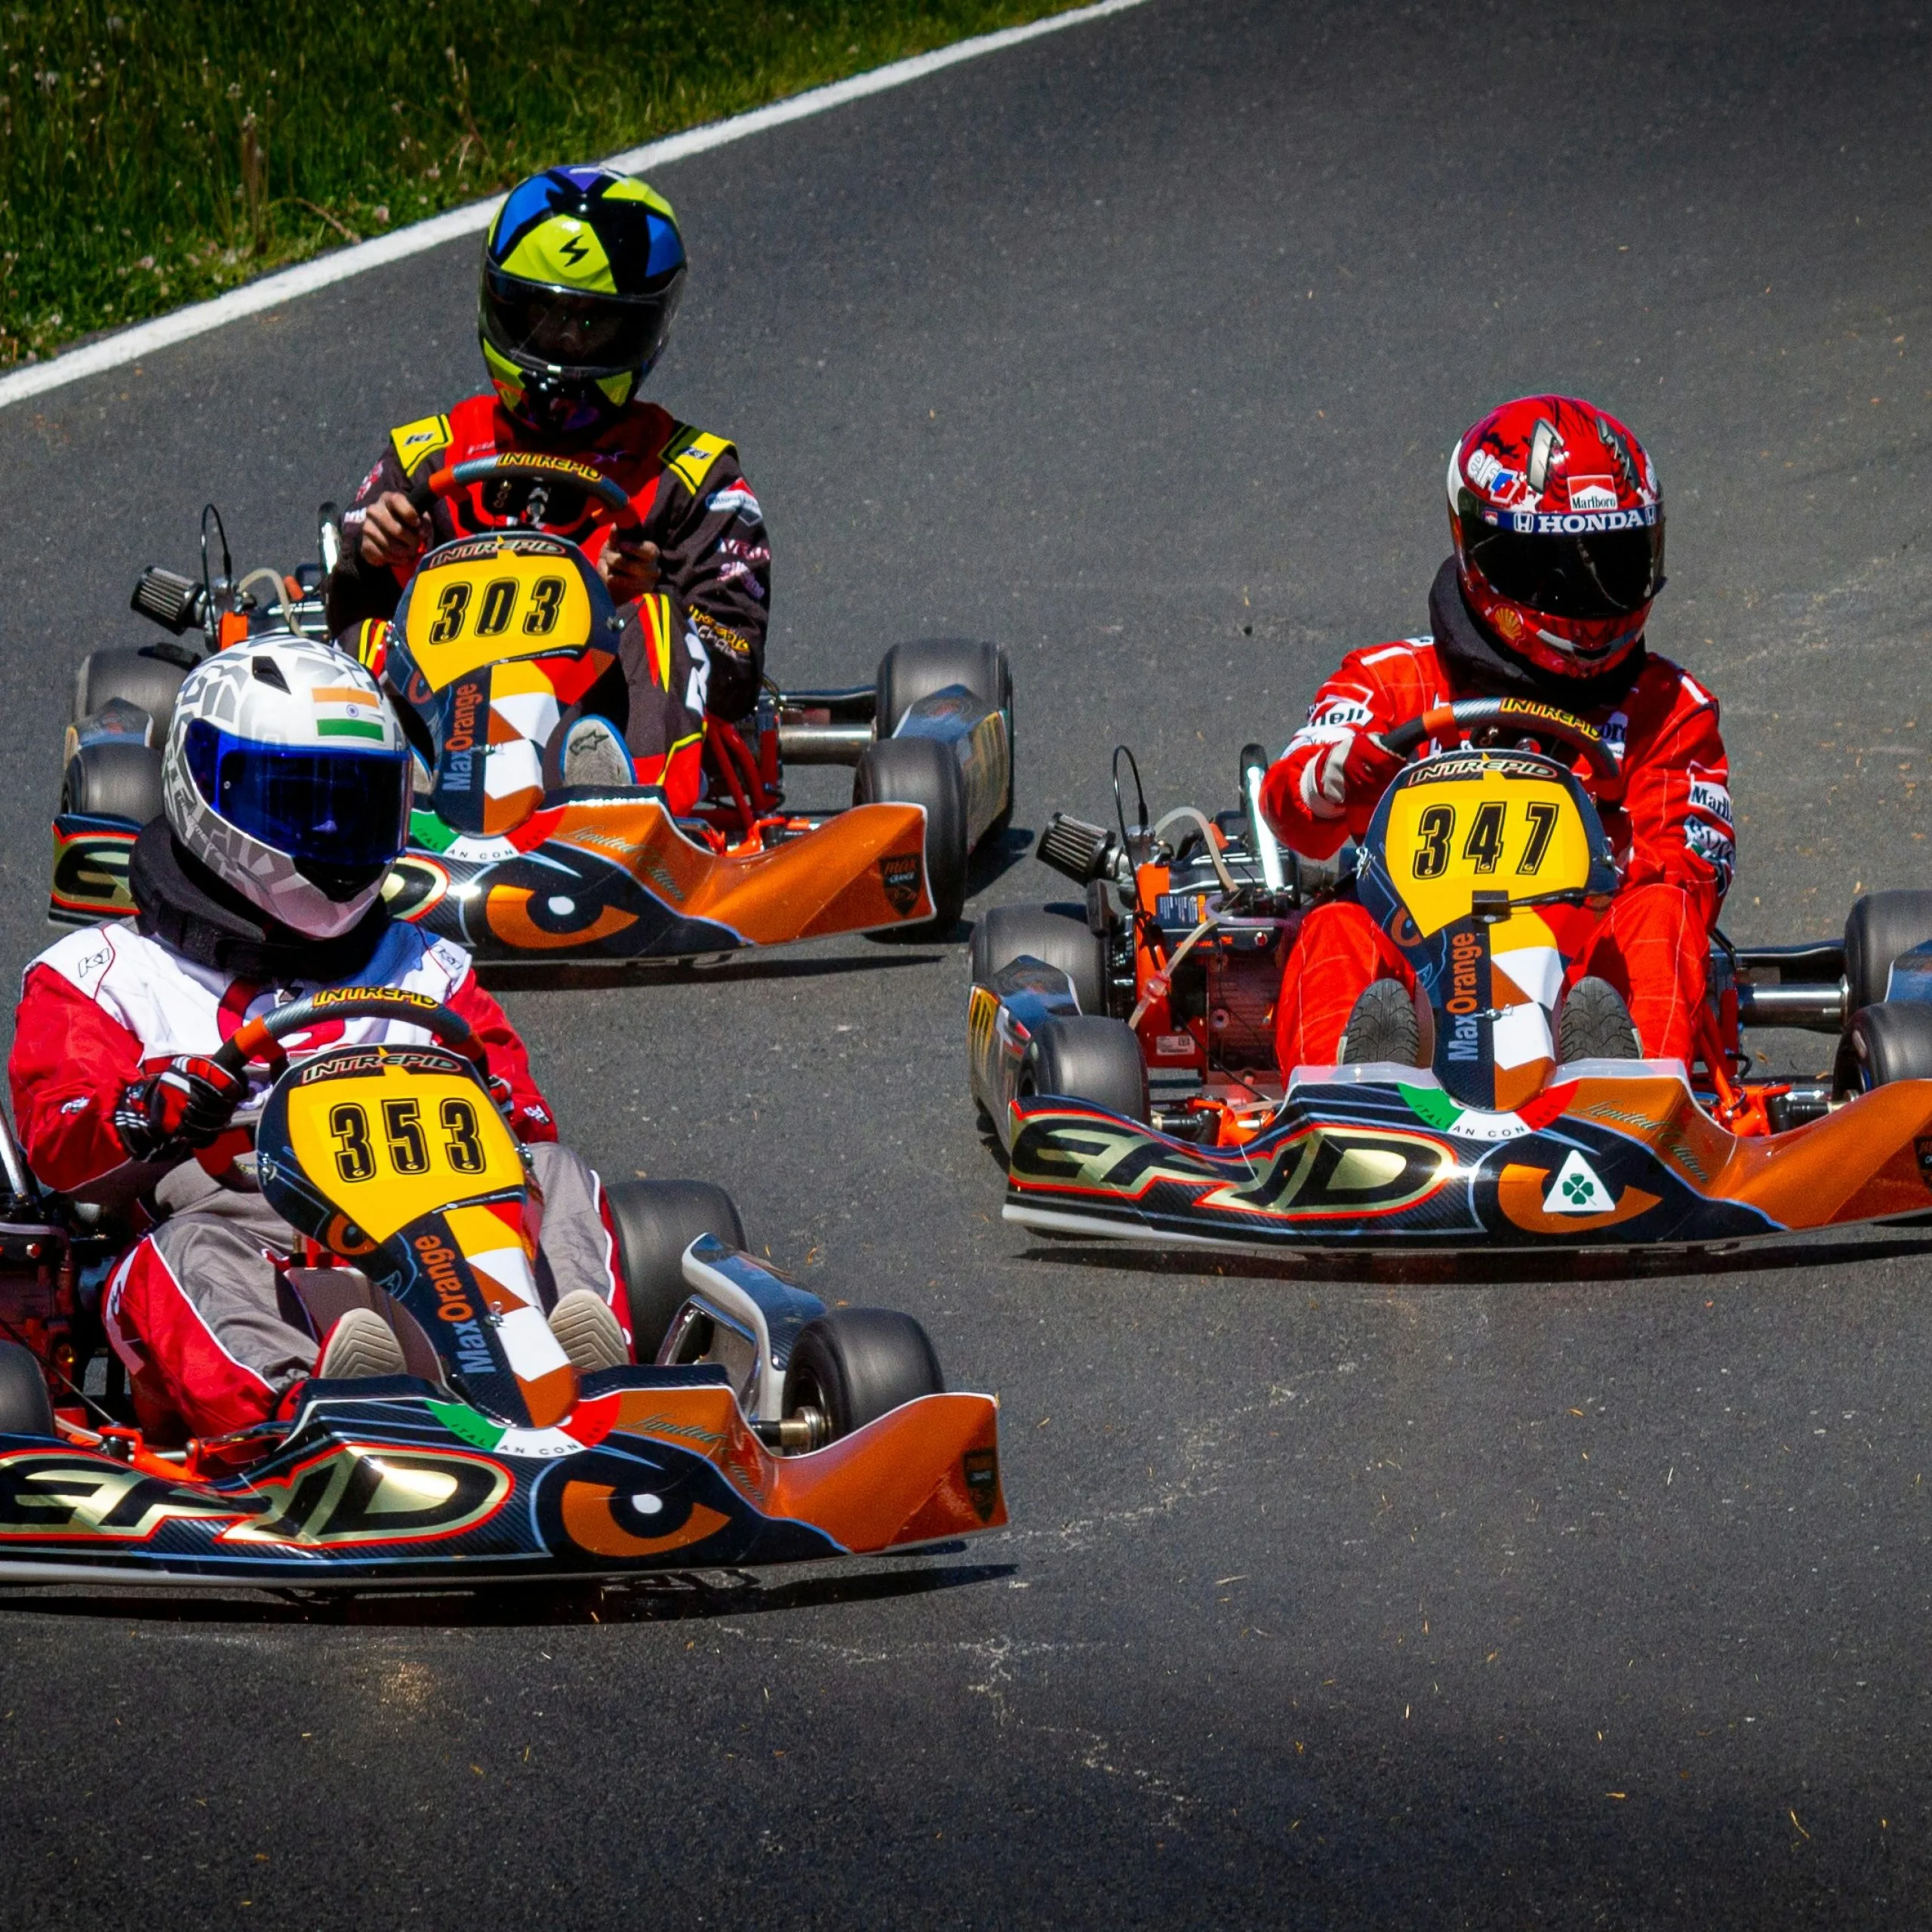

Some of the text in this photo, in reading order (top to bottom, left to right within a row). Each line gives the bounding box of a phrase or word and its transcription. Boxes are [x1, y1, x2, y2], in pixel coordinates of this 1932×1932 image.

[496, 452, 602, 483] INTREPID
[1466, 449, 1503, 489] elf
[1572, 495, 1616, 509] Marlboro
[1539, 509, 1645, 534] HONDA
[429, 539, 566, 569] INTREPID
[429, 576, 566, 645] 303
[1500, 697, 1601, 740] INTREPID
[1408, 759, 1558, 786] INTREPID
[1412, 801, 1559, 879] 347
[312, 986, 439, 1010] INTREPID
[302, 1053, 463, 1084] INTREPID
[329, 1097, 486, 1183] 353
